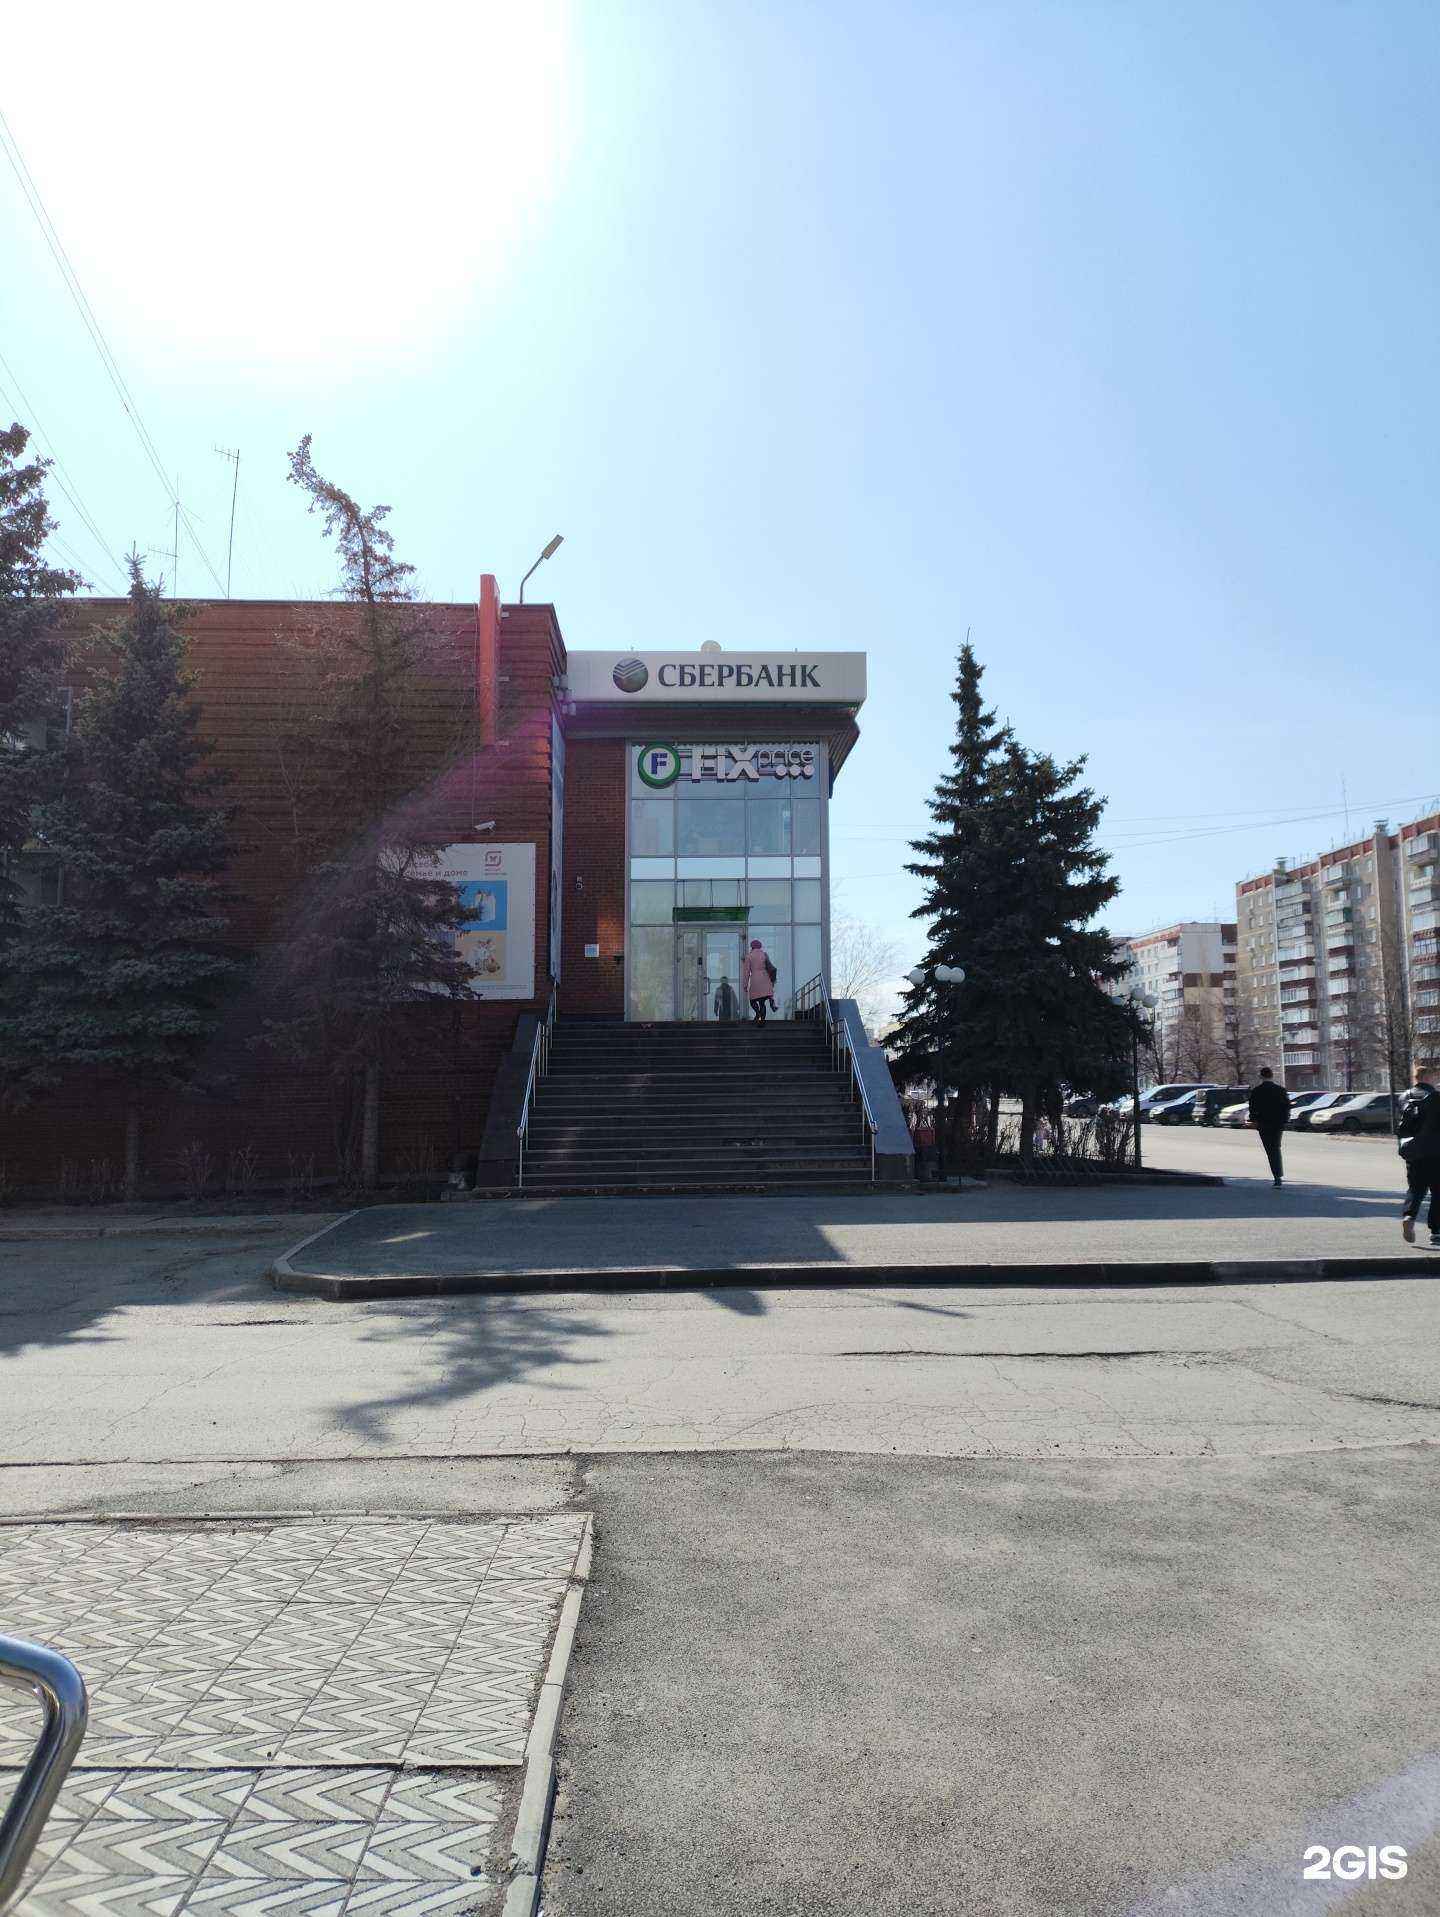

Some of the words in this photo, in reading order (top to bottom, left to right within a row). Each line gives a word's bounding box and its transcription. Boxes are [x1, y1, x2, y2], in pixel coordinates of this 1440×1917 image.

[658, 664, 821, 688] СБЕРБАНК
[650, 752, 668, 775] F
[691, 748, 760, 783] FIX
